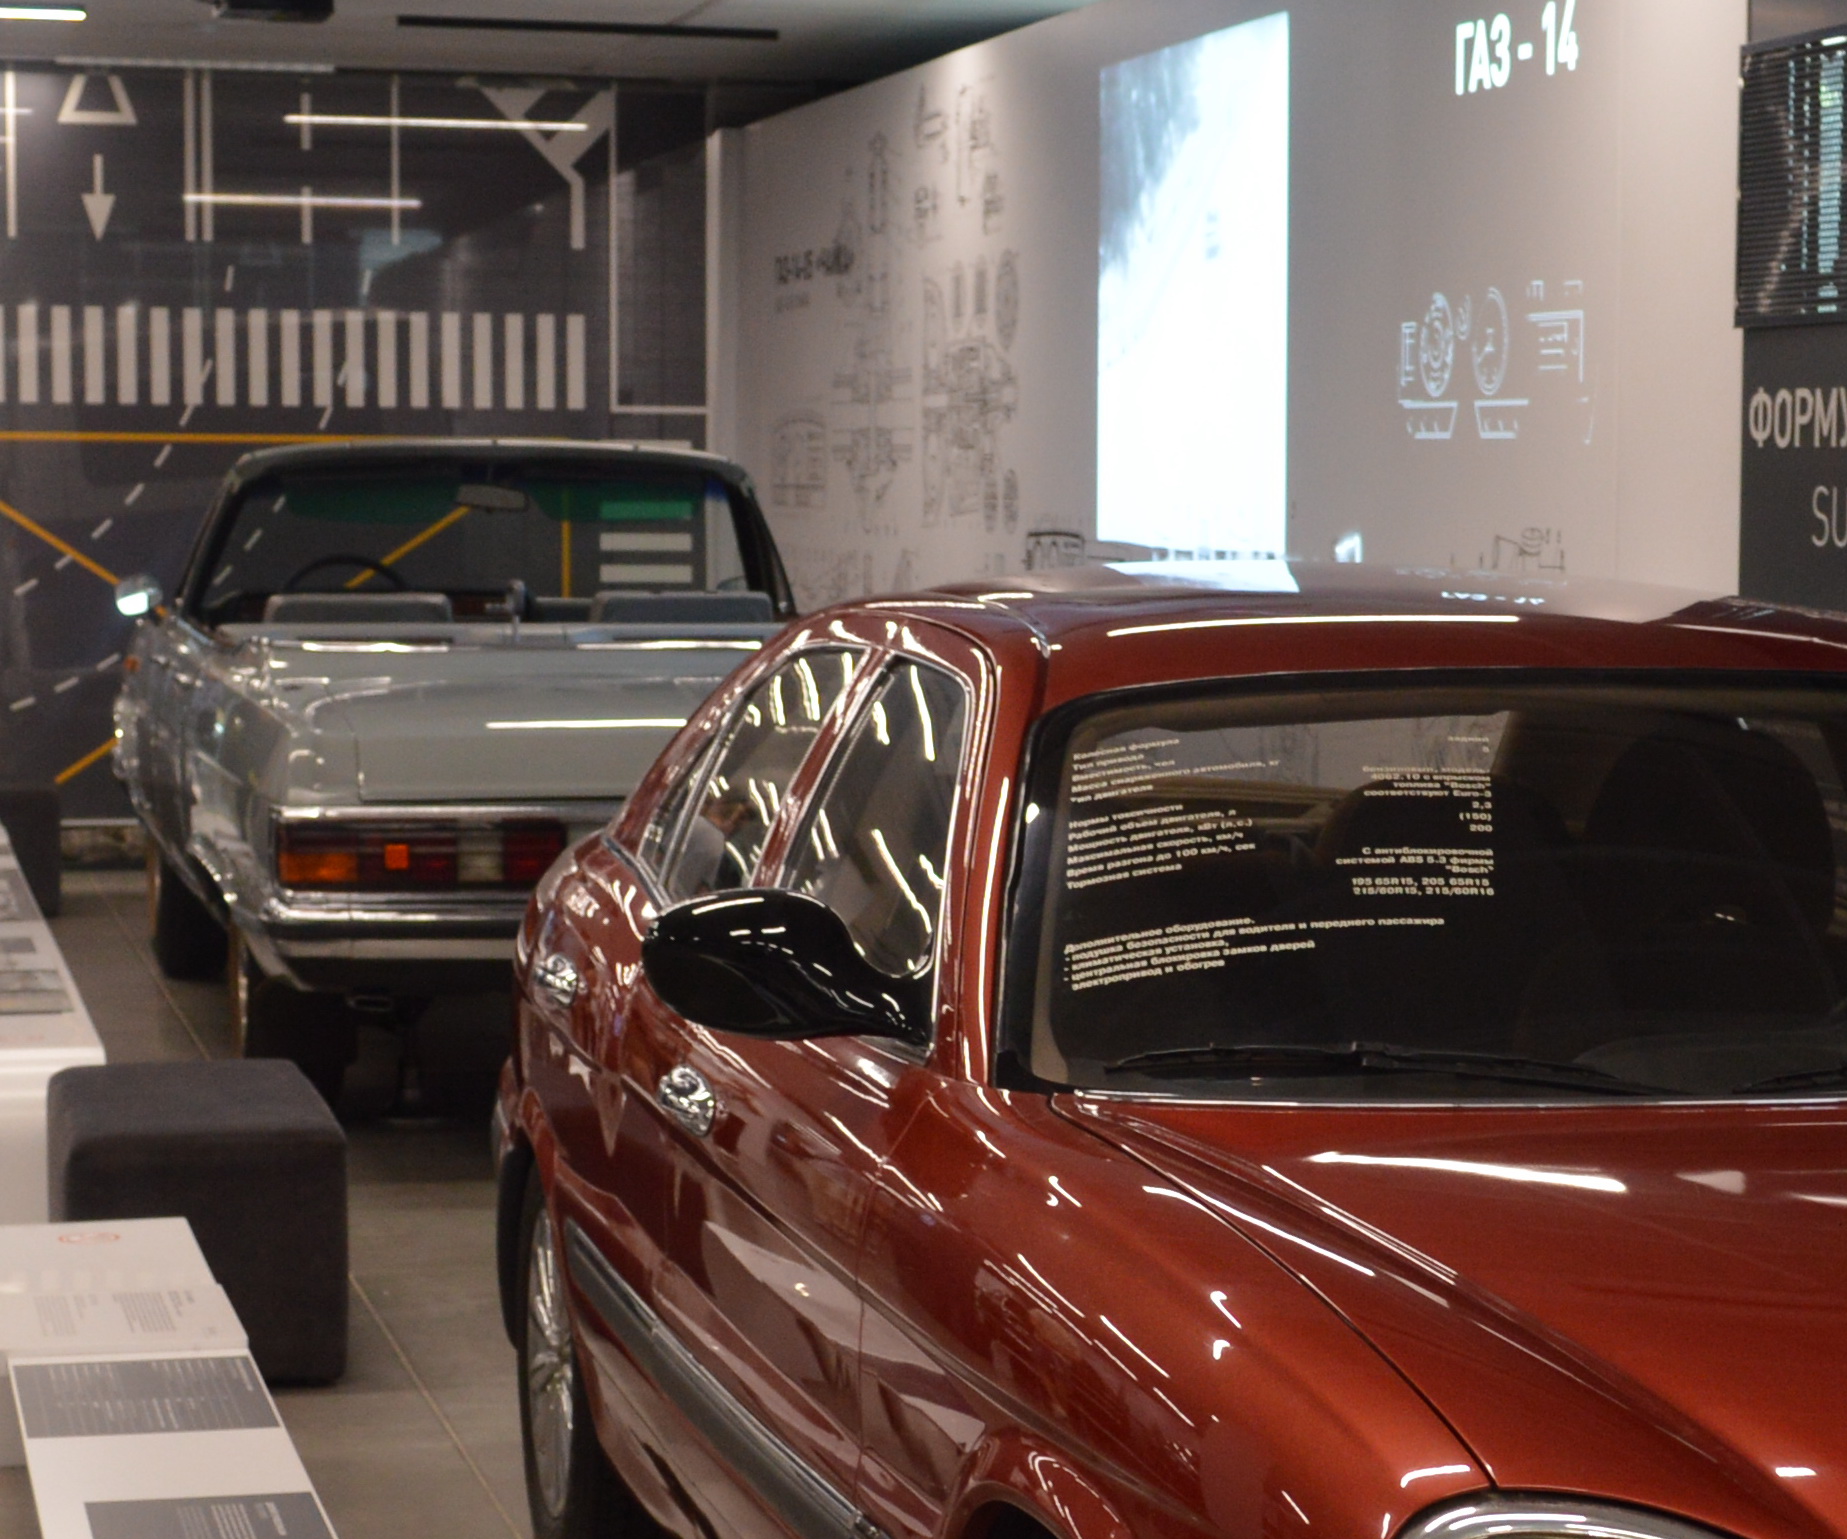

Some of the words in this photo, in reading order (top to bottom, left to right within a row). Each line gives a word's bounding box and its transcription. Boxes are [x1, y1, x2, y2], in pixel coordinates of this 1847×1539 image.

[1455, 13, 1511, 96] ГАЗ
[1541, 0, 1579, 76] 14
[1067, 824, 1118, 842] Рабочий
[1068, 815, 1110, 830] Нормы
[1469, 824, 1494, 833] 200
[1066, 842, 1155, 867] Максимальная
[1067, 836, 1129, 854] Мощность
[1066, 863, 1106, 878] Время
[1106, 854, 1155, 871] разгона
[1175, 847, 1199, 859] 100
[1335, 856, 1396, 866] системой
[1399, 855, 1424, 865] ABS
[1067, 871, 1131, 890] Тормозная
[1131, 863, 1183, 878] система
[1064, 928, 1164, 955] Дополнительное
[1071, 943, 1124, 962] подушка
[1126, 930, 1211, 950] безопасности
[1212, 927, 1237, 940] для
[1237, 921, 1296, 936] водителя
[1309, 918, 1376, 931] переднего
[1377, 917, 1446, 928] пассажира
[1071, 946, 1164, 972] климатическая
[1071, 959, 1149, 982] центральная
[1150, 948, 1221, 966] блокировка
[1222, 944, 1268, 957] замков
[1269, 939, 1316, 953] дверей
[1071, 967, 1164, 992] электропривод
[1176, 958, 1226, 973] обогрев
